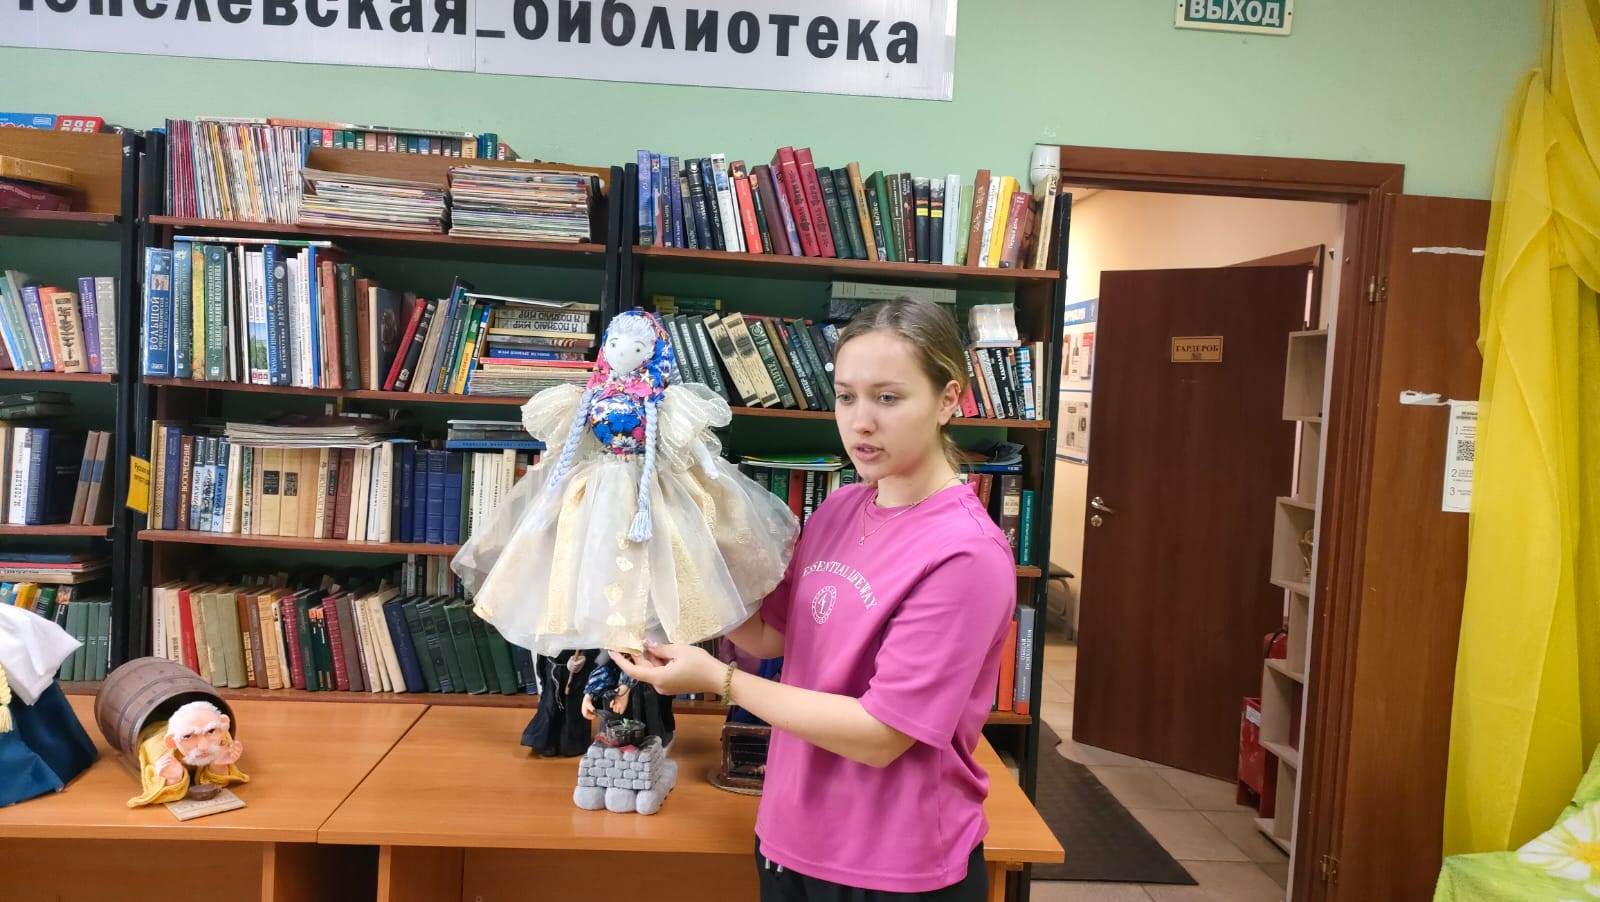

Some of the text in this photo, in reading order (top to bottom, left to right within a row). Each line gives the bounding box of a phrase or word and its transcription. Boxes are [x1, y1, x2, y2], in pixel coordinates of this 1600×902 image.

[1189, 0, 1280, 26] ВЫХОД
[518, 311, 537, 320] МИР
[538, 312, 573, 322] ПОЗНАЮ
[149, 296, 160, 351] БОЛЬШОЙ
[512, 320, 578, 332] Я ПОЗНАЮ МИР
[1176, 345, 1219, 353] ГАРДЕРОБ
[181, 443, 191, 492] ВОСКРЕСЕНИЕ
[1450, 469, 1458, 478] 2
[1449, 487, 1456, 496] 3
